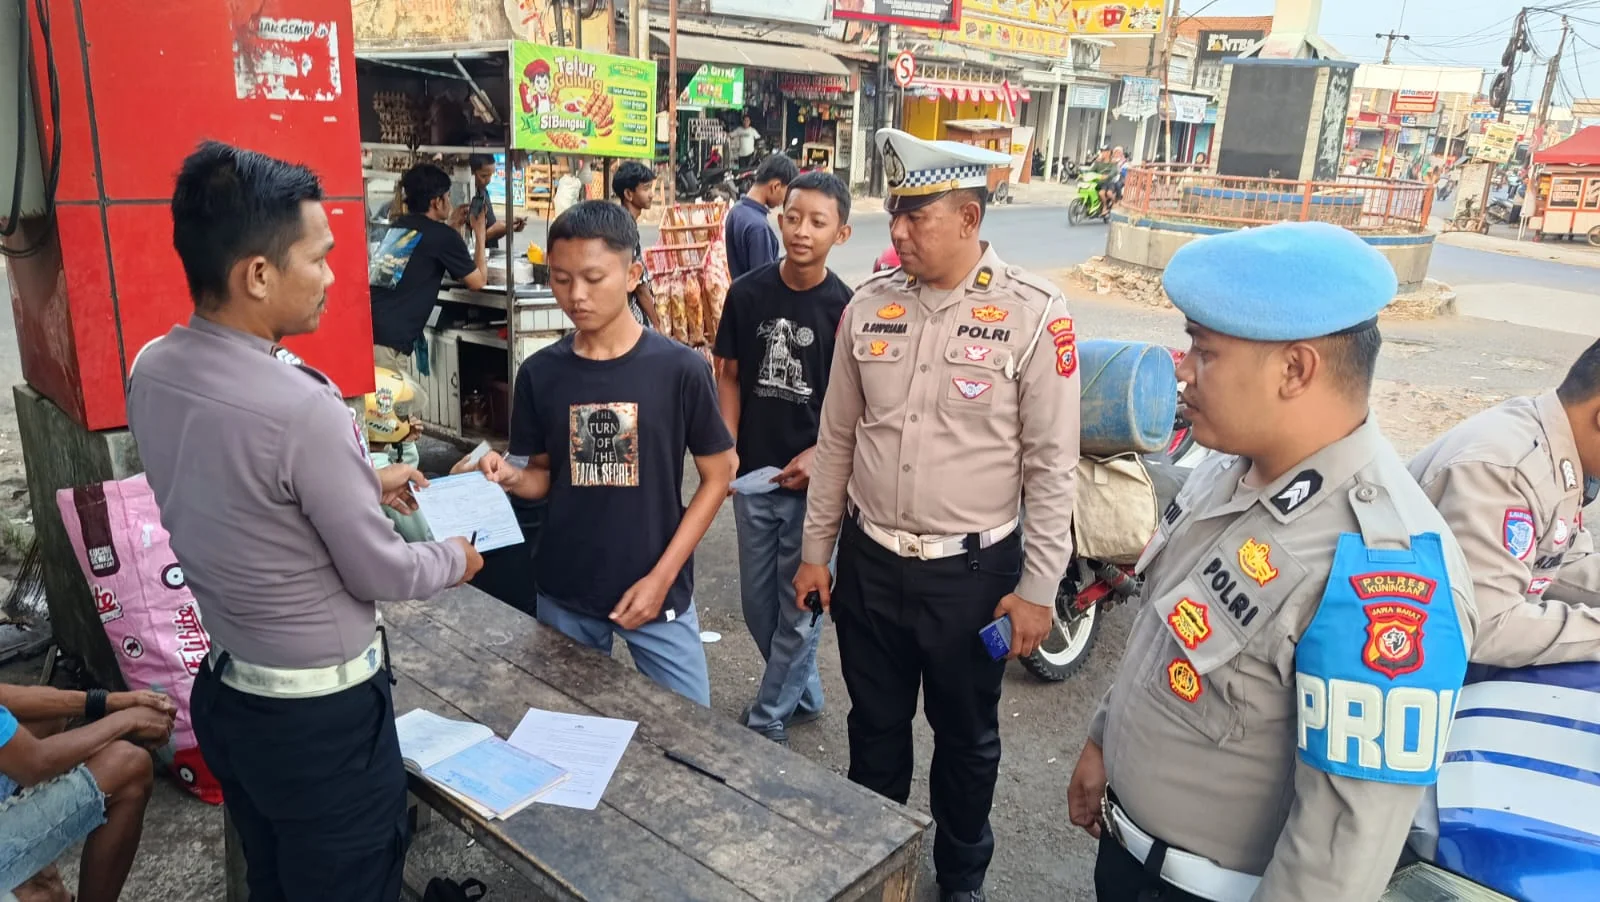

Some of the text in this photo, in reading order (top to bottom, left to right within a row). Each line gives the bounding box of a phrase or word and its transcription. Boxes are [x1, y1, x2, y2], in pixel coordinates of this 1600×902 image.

[553, 56, 597, 79] Telur
[900, 57, 910, 79] S
[553, 71, 603, 93] Gulung
[957, 324, 1011, 342] POLRI
[595, 411, 612, 420] THE
[589, 422, 620, 434] TURN
[596, 438, 611, 448] OF
[594, 451, 615, 463] THE
[575, 462, 636, 486] FATAL SECRET
[1362, 576, 1426, 591] POLRES
[1367, 583, 1422, 596] KUNINGAN
[1203, 557, 1259, 627] POLRI
[1371, 606, 1421, 620] JAWA BARAT
